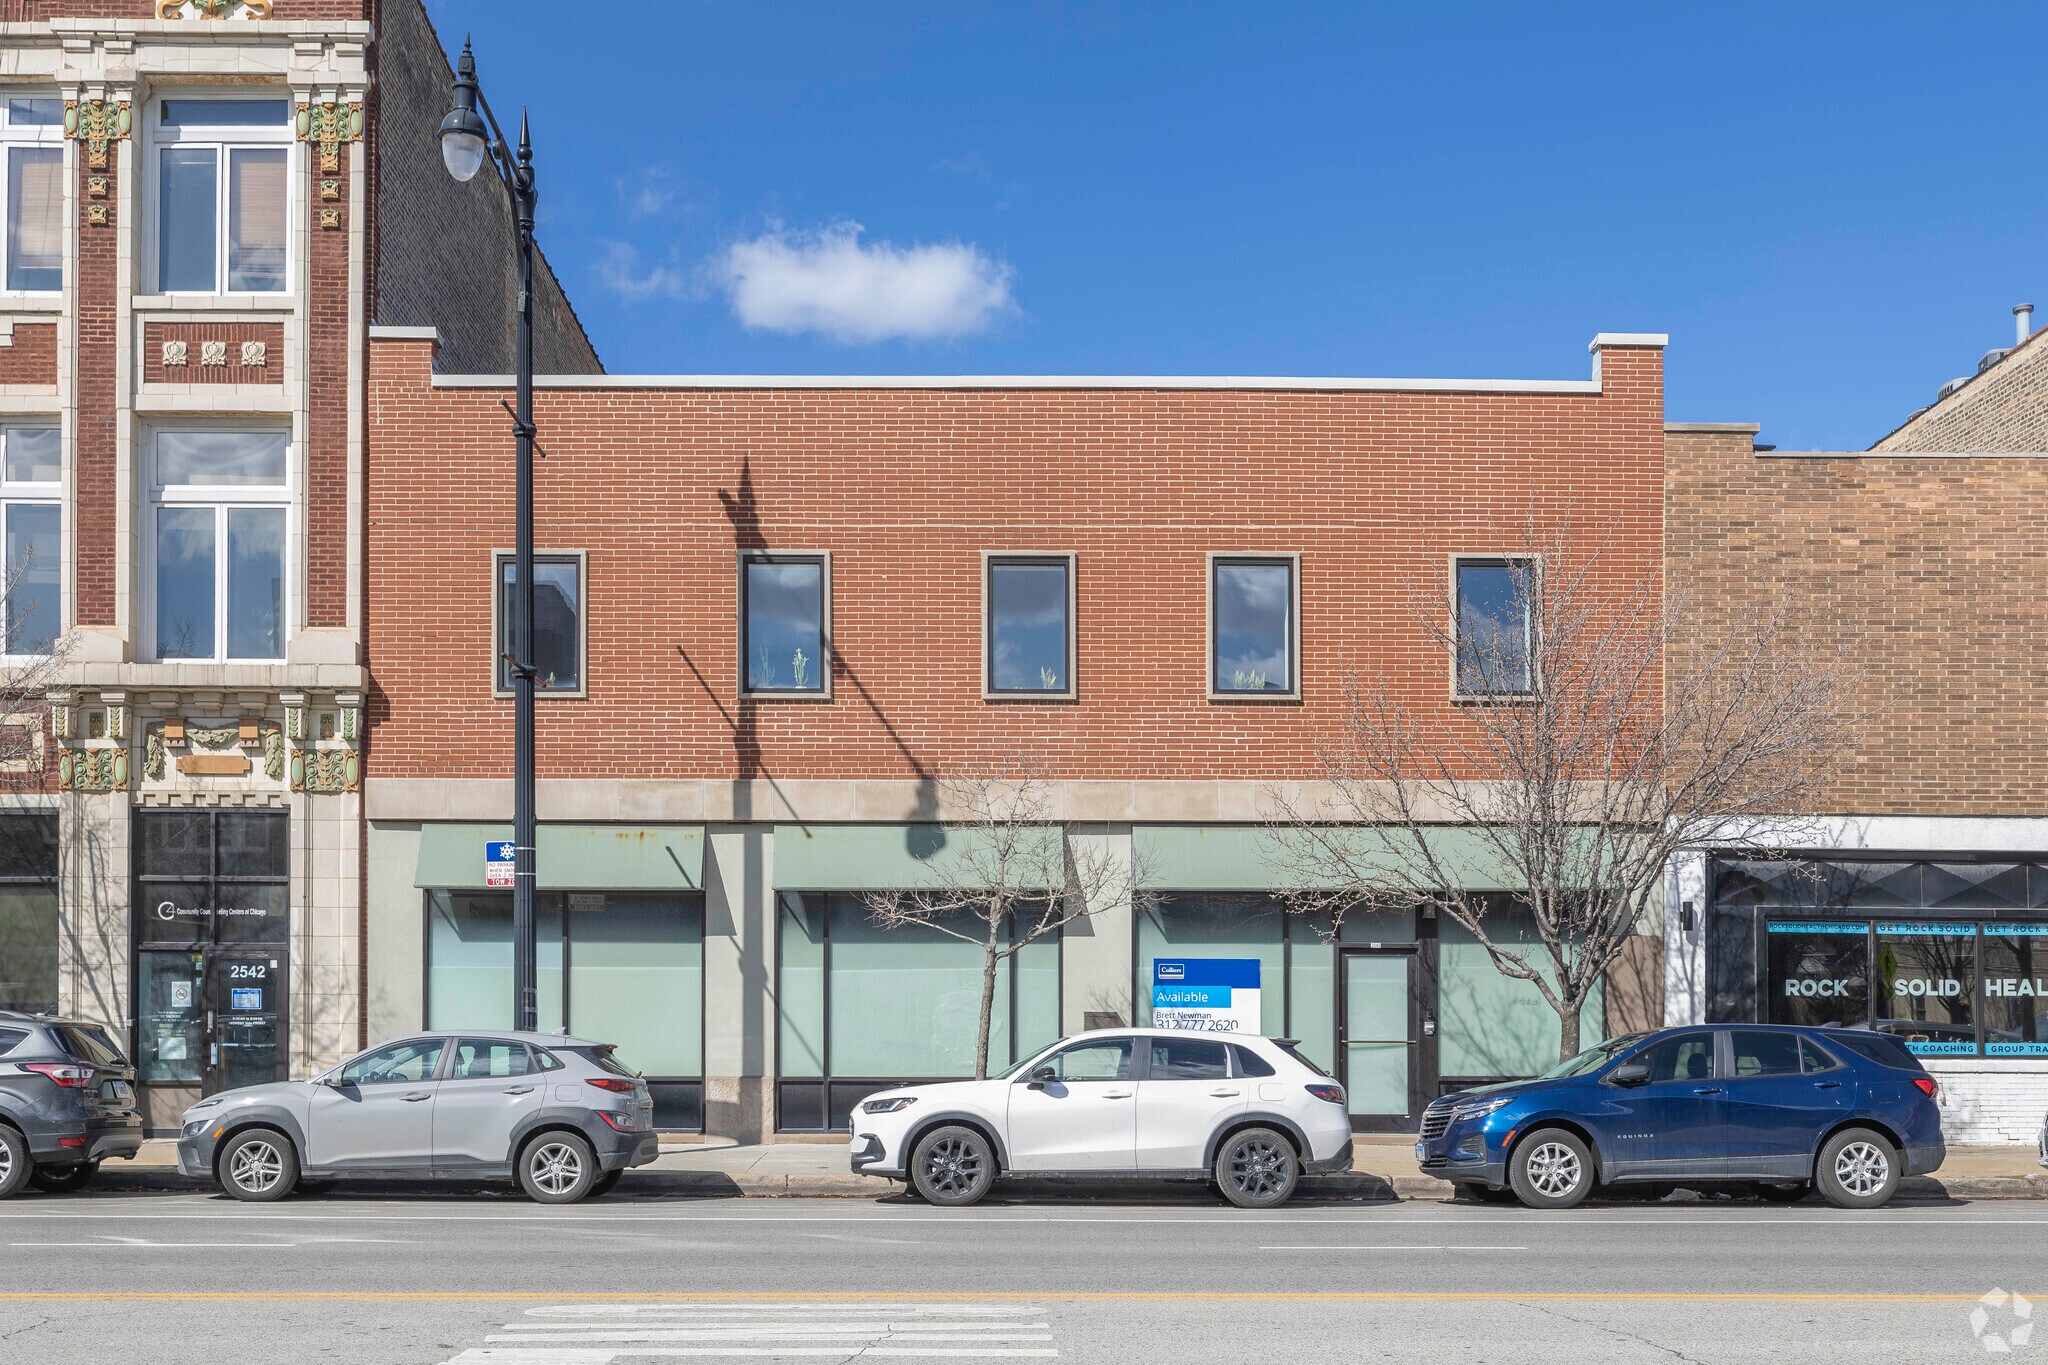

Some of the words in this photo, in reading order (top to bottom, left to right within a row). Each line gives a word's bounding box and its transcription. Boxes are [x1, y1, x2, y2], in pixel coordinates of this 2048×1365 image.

[176, 907, 199, 917] Community
[229, 907, 244, 916] Centers
[245, 908, 250, 916] of
[250, 907, 267, 917] Chicago
[1879, 924, 1901, 932] GET
[1906, 924, 1934, 932] ROCK
[1939, 924, 1971, 933] SOLID
[1986, 925, 2008, 933] GET
[2013, 925, 2041, 933] ROCK
[230, 965, 266, 979] 2542
[1785, 979, 1849, 997] ROCK
[1894, 978, 1961, 997] SOLID
[1985, 978, 2048, 997] HEAL
[1156, 992, 1208, 1003] Available
[1182, 1020, 1205, 1031] 777
[1207, 1020, 1239, 1032] 2620
[1922, 1045, 1974, 1053] COACHING
[1991, 1045, 2025, 1053] GROUP
